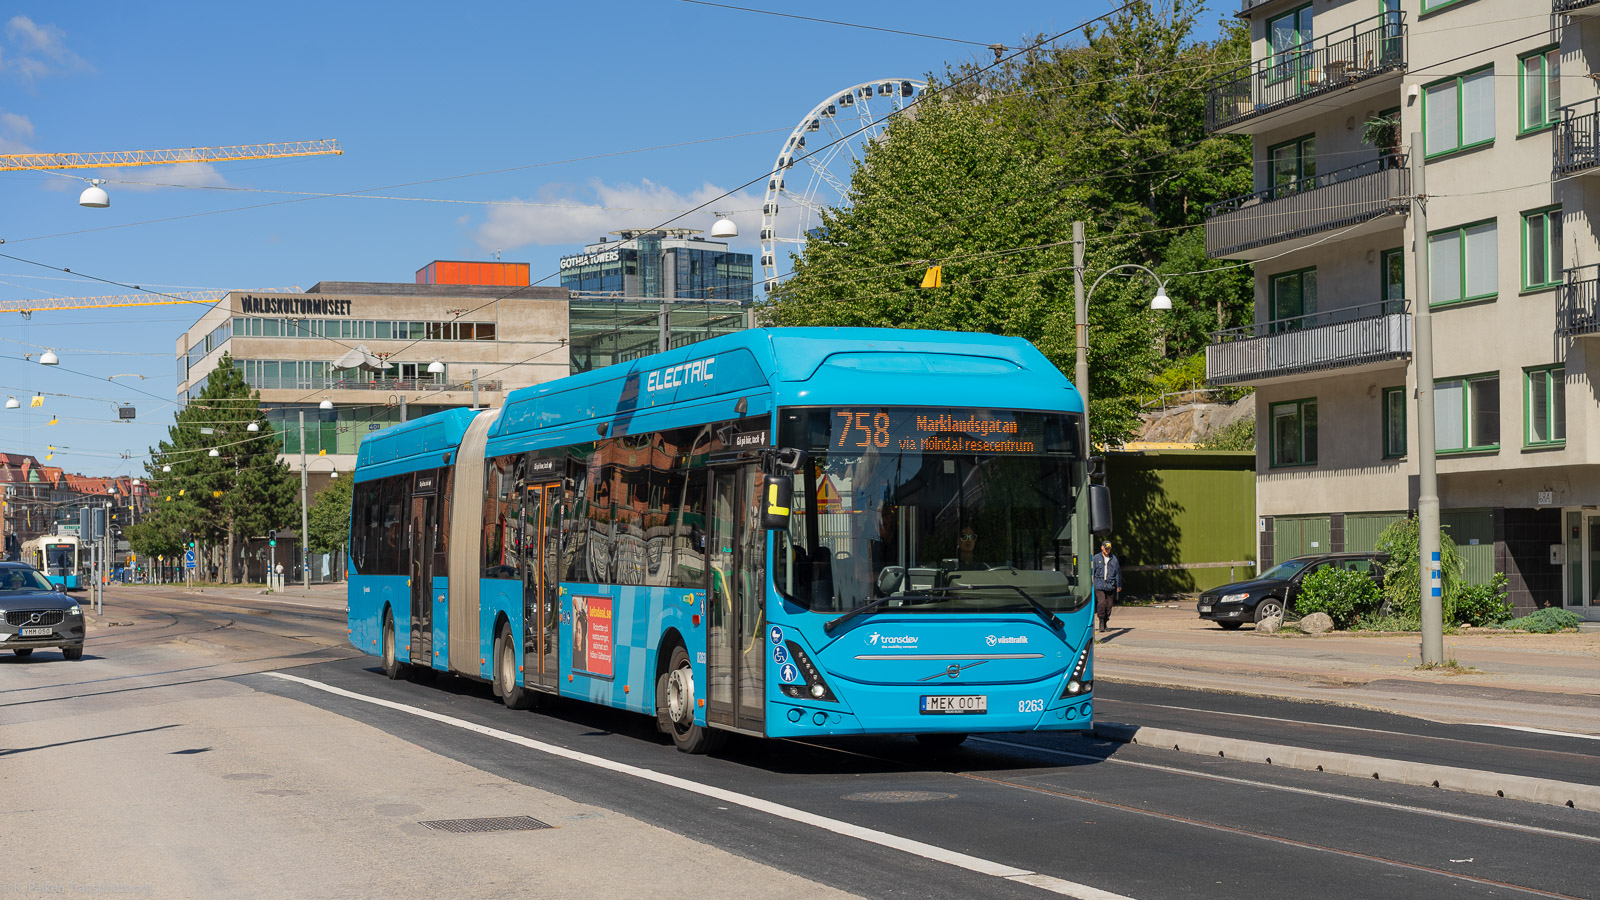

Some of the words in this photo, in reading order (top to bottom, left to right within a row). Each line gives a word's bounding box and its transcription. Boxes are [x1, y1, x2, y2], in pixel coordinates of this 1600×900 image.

[560, 255, 589, 269] GOTHIA
[589, 251, 619, 264] TOWERS
[241, 295, 352, 315] VÄRLDSKULTURMUSEET
[647, 358, 715, 392] ELECTRIC
[837, 412, 890, 448] 758
[916, 414, 1018, 436] Marklandsgatan
[898, 435, 917, 450] via
[965, 438, 1034, 452] resecentrum
[880, 635, 919, 644] transdev
[997, 635, 1029, 644] västtrafik
[931, 698, 954, 709] MEK
[1018, 699, 1043, 712] 8263
